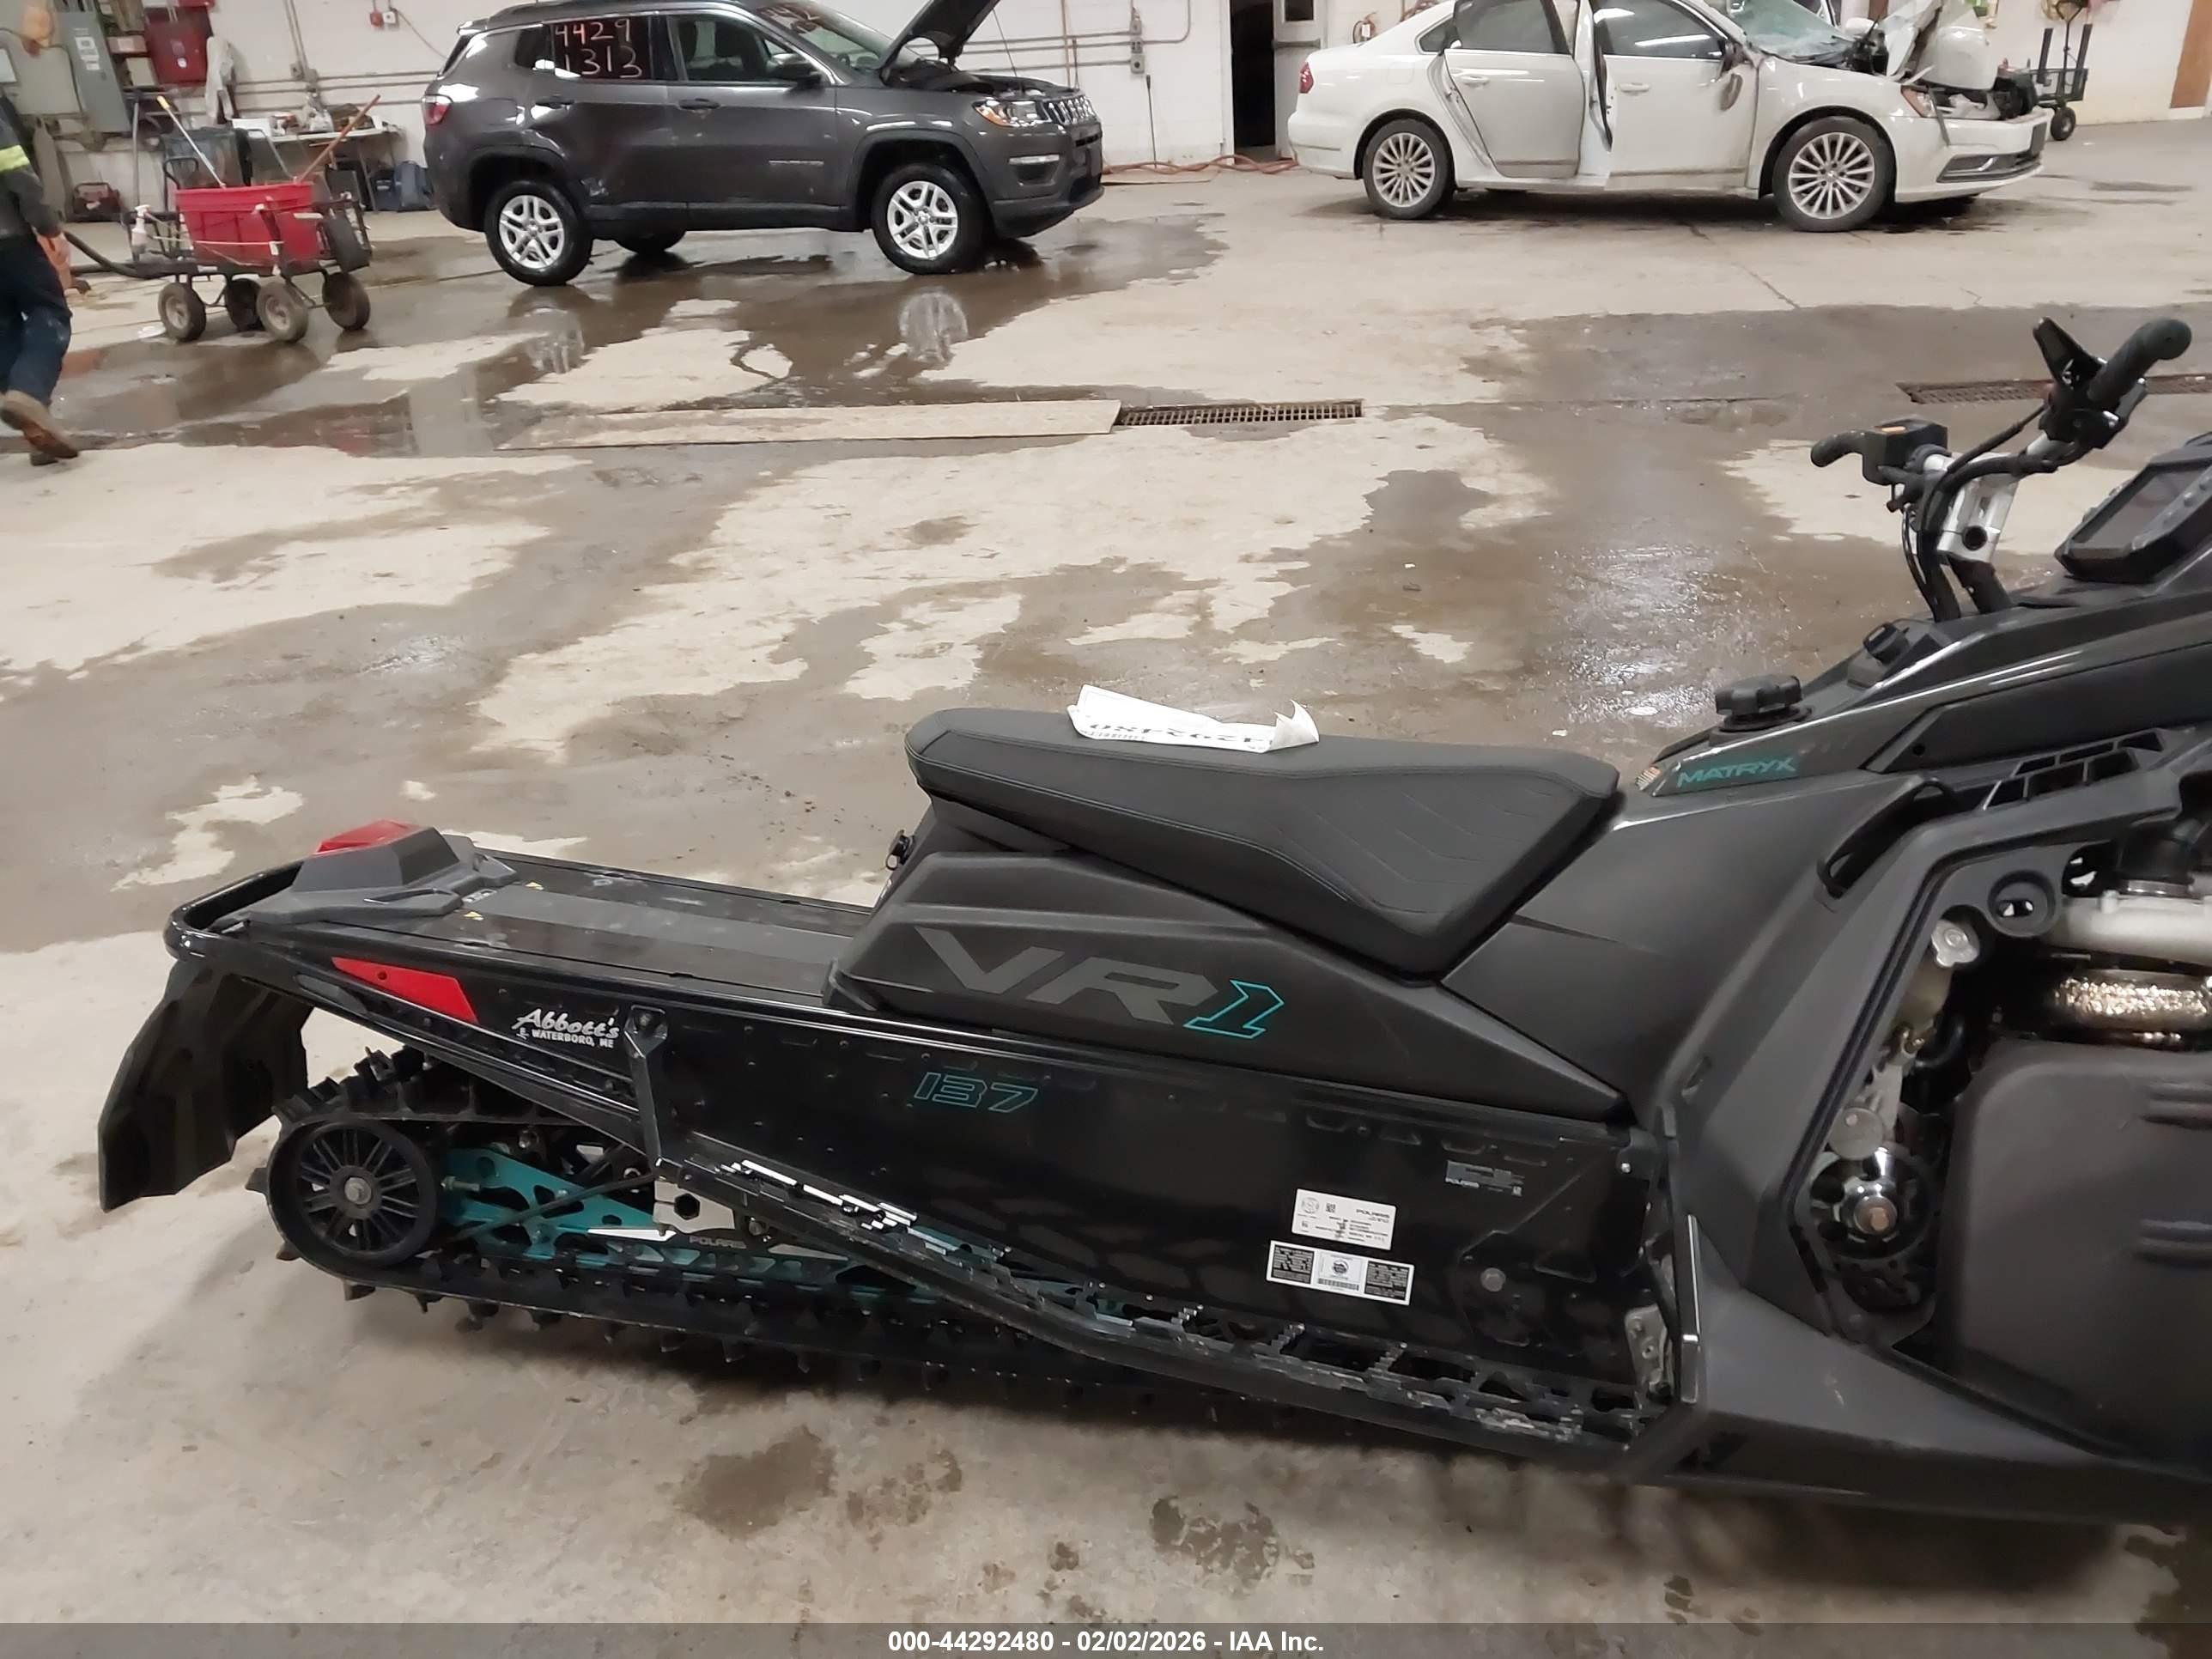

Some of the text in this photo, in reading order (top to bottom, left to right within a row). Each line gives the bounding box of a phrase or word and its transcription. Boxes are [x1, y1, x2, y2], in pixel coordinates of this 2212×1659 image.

[554, 19, 630, 46] 4429
[565, 46, 643, 78] 1313
[1677, 757, 1796, 787] MATRYX
[915, 927, 1285, 1039] VR1
[511, 1008, 620, 1038] Abbott's
[914, 1072, 1037, 1113] 137
